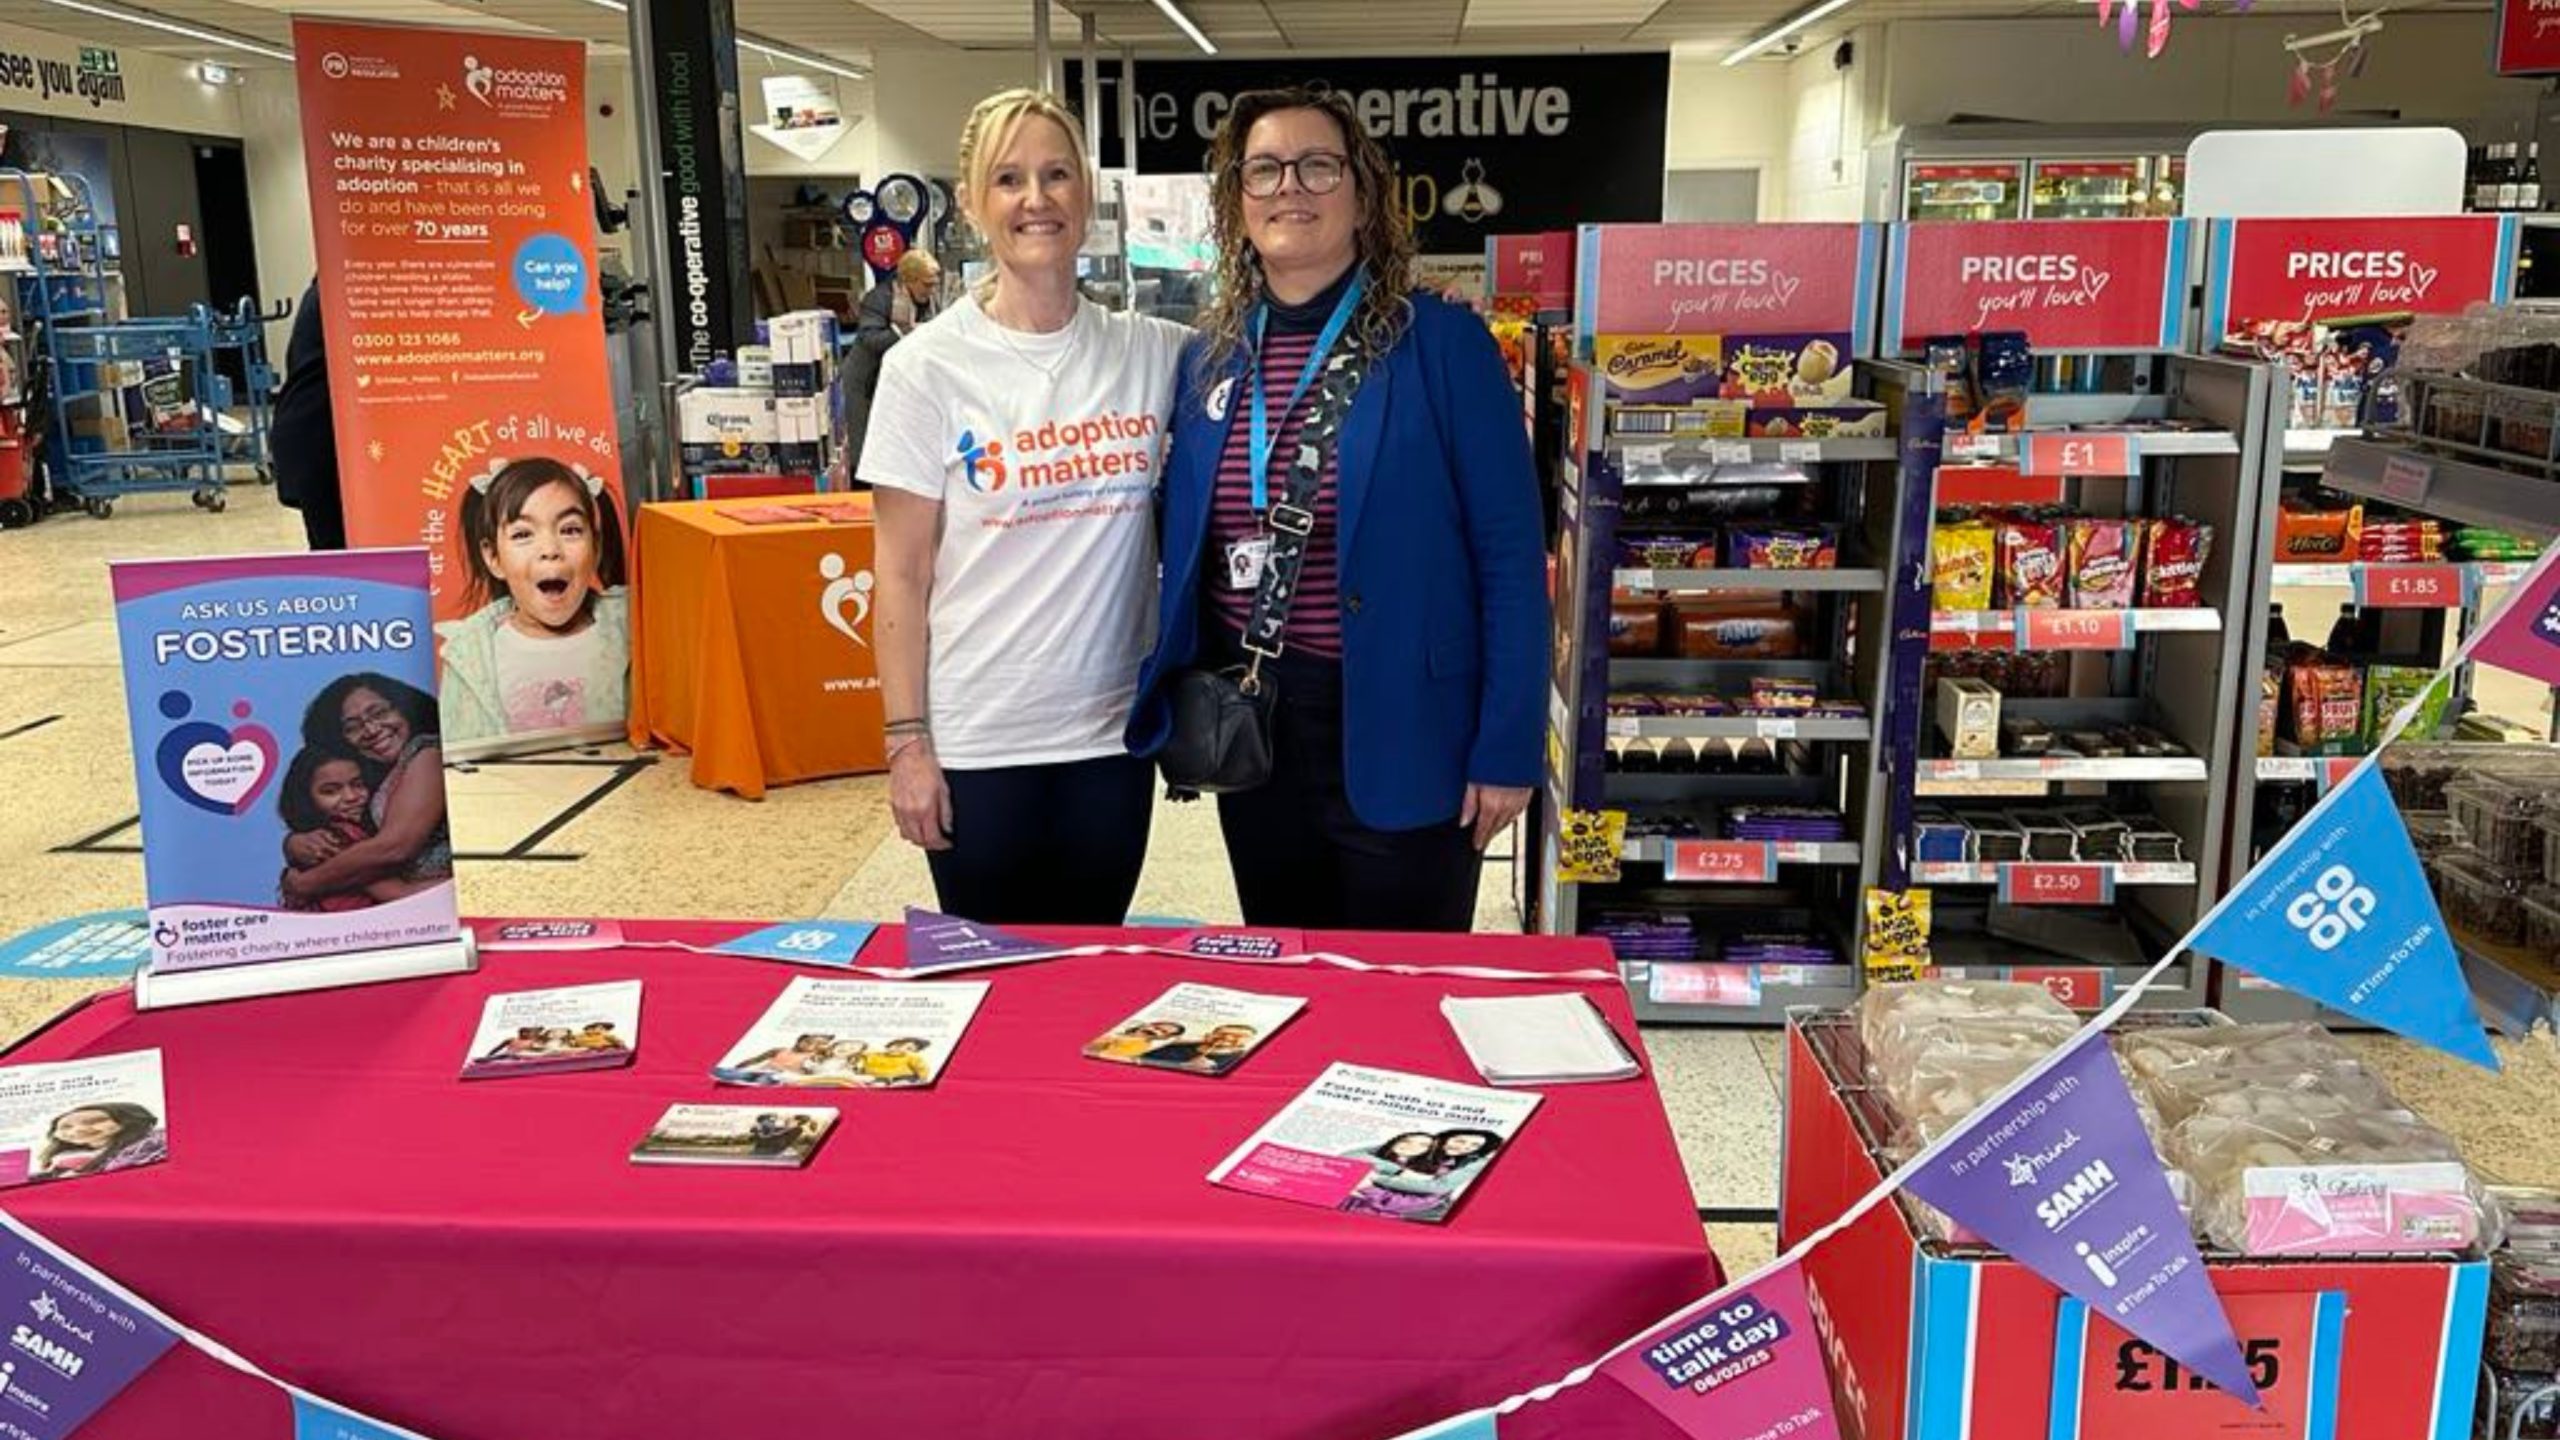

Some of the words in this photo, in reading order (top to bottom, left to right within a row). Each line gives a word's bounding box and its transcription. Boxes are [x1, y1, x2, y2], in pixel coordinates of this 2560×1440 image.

[0, 52, 33, 88] see
[37, 58, 72, 99] you
[77, 69, 125, 107] again
[495, 69, 567, 86] adoption
[667, 51, 690, 96] food
[496, 84, 567, 101] matters
[1080, 77, 1177, 139] The
[1193, 73, 1570, 137] cerative
[671, 100, 696, 142] with
[332, 132, 363, 149] We
[368, 136, 397, 149] are
[401, 137, 412, 150] a
[417, 136, 501, 153] children's
[334, 155, 396, 174] charity
[402, 157, 503, 177] specialising
[509, 160, 525, 175] in
[679, 144, 701, 194] good
[336, 177, 418, 194] adoption
[437, 180, 471, 194] that
[476, 181, 490, 194] is
[495, 181, 513, 195] all
[518, 183, 540, 196] we
[340, 198, 364, 213] do
[370, 199, 401, 214] and
[405, 200, 445, 215] have
[450, 201, 493, 216] been
[498, 202, 546, 218] doing
[340, 221, 365, 236] for
[372, 222, 410, 236] over
[415, 221, 436, 236] 70
[441, 223, 489, 239] years
[525, 260, 552, 274] Can
[555, 262, 578, 277] you
[679, 196, 709, 327] co-operative
[1653, 259, 1769, 287] PRICES
[1961, 254, 2079, 283] PRICES
[2287, 250, 2406, 279] PRICES
[535, 276, 571, 292] help?
[1666, 291, 1727, 333] you'll
[1734, 288, 1778, 312] love
[1970, 287, 2038, 331] you'll
[2043, 284, 2086, 308] love
[2300, 285, 2360, 326] you'll
[2369, 281, 2413, 304] love
[352, 334, 394, 346] 0300
[398, 333, 421, 346] 123
[426, 332, 461, 346] 1066
[688, 330, 711, 367] The
[354, 350, 544, 366] www.adoptionmatters.org
[1606, 339, 1689, 377] Caramel
[496, 415, 518, 441] of
[526, 413, 550, 439] all
[556, 422, 587, 445] we
[1015, 410, 1158, 452] adoption
[422, 419, 492, 500] HEART
[1019, 450, 1149, 489] matters
[2061, 442, 2095, 467] £1
[422, 508, 446, 543] the
[429, 552, 445, 576] at
[2389, 578, 2438, 594] £1.85
[181, 601, 230, 621] ASK
[238, 598, 269, 617] US
[277, 594, 359, 615] ABOUT
[155, 619, 414, 665] FOSTERING
[2052, 619, 2099, 635] £1.10
[204, 776, 238, 786] TODAY
[1573, 837, 1607, 852] Mini
[1698, 850, 1744, 870] £2.75
[2033, 874, 2081, 890] £2.50
[2246, 906, 2260, 921] In
[2257, 848, 2322, 912] partnership
[2320, 826, 2349, 851] with
[182, 917, 230, 934] foster
[234, 914, 269, 928] care
[183, 930, 248, 947] matters
[166, 946, 239, 965] Fostering
[241, 940, 291, 957] charity
[295, 934, 340, 949] where
[344, 929, 400, 943] children
[404, 924, 451, 935] matter
[2349, 924, 2434, 1004] #TimeToTalk
[1316, 1088, 1364, 1103] make
[1367, 1098, 1440, 1117] children
[1444, 1110, 1508, 1127] matter
[1323, 1081, 1378, 1097] Foster
[1384, 1092, 1421, 1104] with
[1426, 1100, 1446, 1109] us
[1450, 1103, 1486, 1114] and
[1949, 1161, 1969, 1177] In
[1967, 1101, 2047, 1167] partnership
[2046, 1074, 2081, 1102] with
[2031, 1129, 2082, 1171] mind
[2036, 1159, 2114, 1229] SAMH
[2101, 1224, 2149, 1263] Inspire
[16, 1251, 31, 1267] In
[31, 1264, 106, 1315] partnership
[107, 1309, 137, 1333] with
[2115, 1255, 2190, 1315] #TimeToTalk
[52, 1311, 95, 1344] mind
[1651, 1321, 1721, 1365] time
[1719, 1302, 1754, 1327] to
[11, 1323, 84, 1377] SAMH
[1666, 1345, 1728, 1384] talk
[1726, 1316, 1780, 1354] day
[2115, 1339, 2280, 1391] £1.5
[1693, 1350, 1771, 1394] 06/02/25
